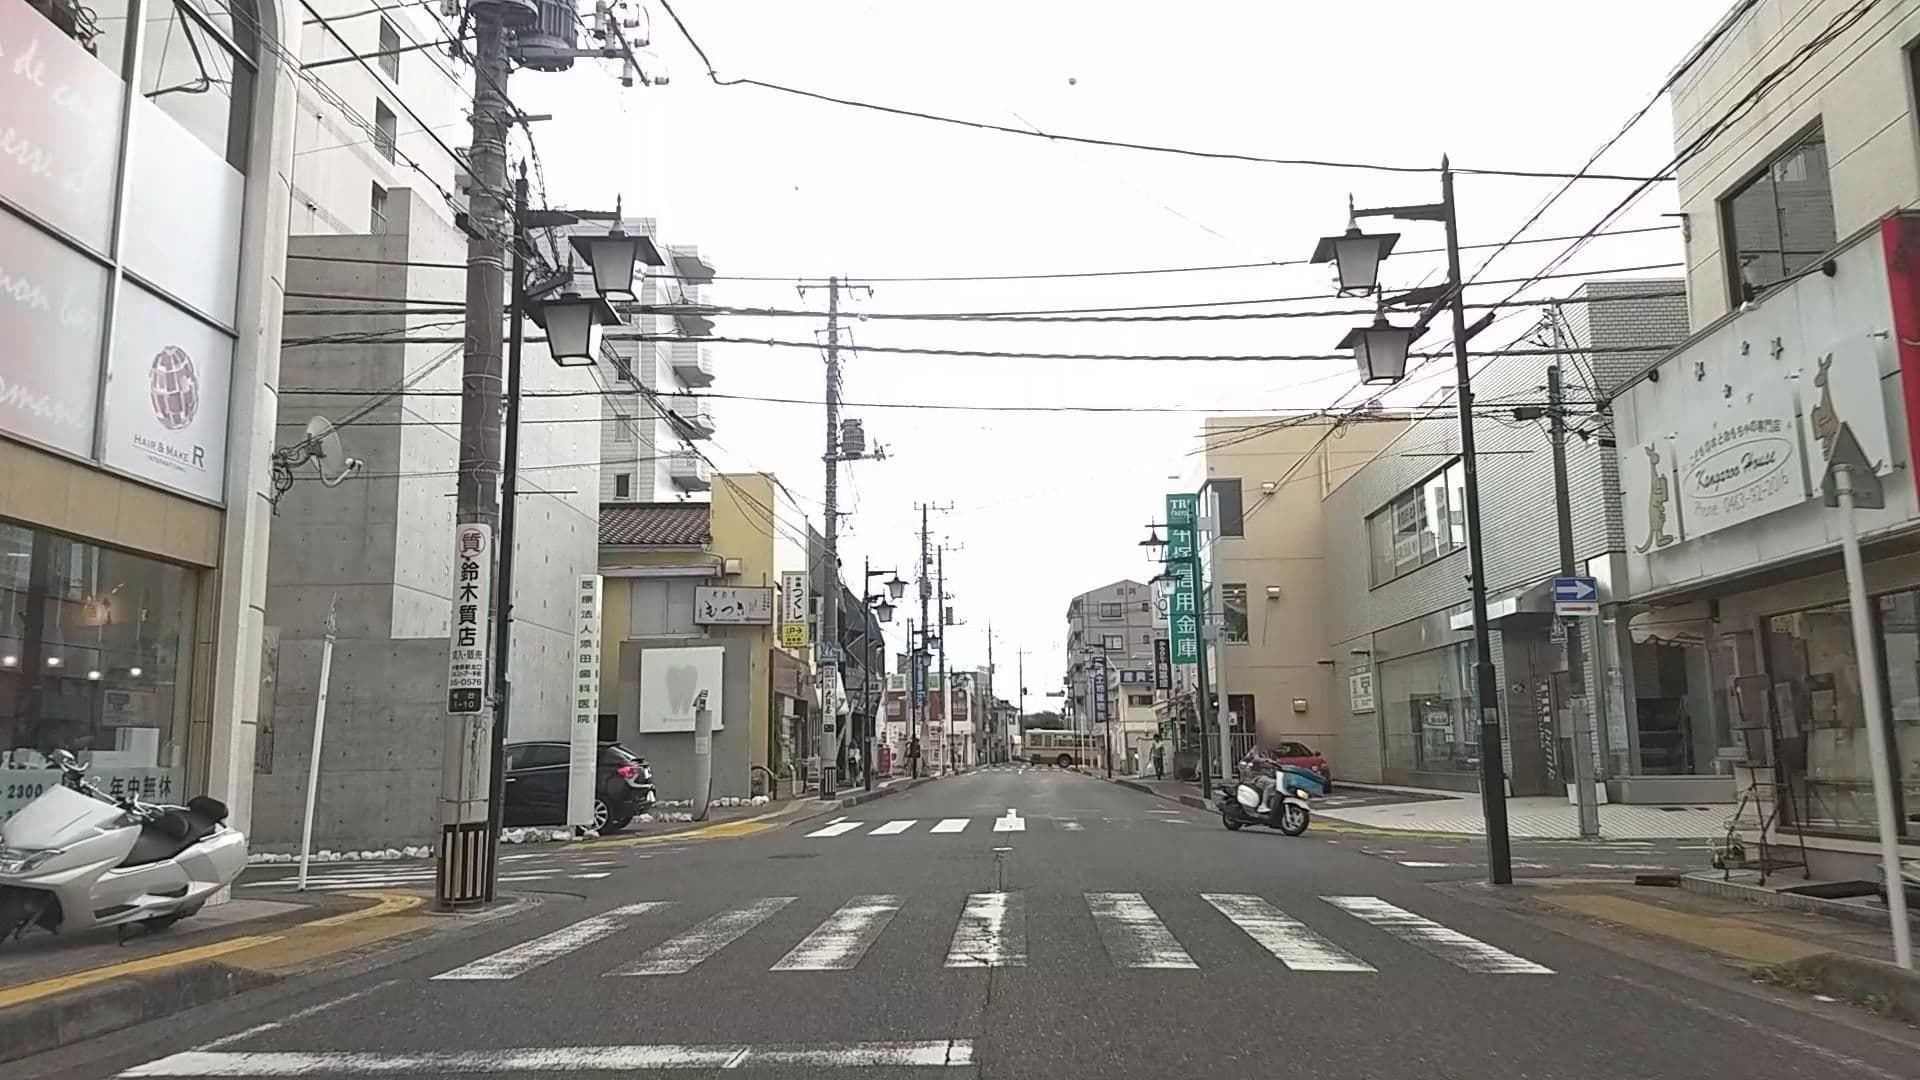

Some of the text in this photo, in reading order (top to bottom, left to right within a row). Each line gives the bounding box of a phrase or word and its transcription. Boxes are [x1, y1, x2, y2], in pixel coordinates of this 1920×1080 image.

[462, 532, 482, 554] 質
[457, 560, 480, 647] 鈴木質店
[110, 775, 172, 799] 年中無休
